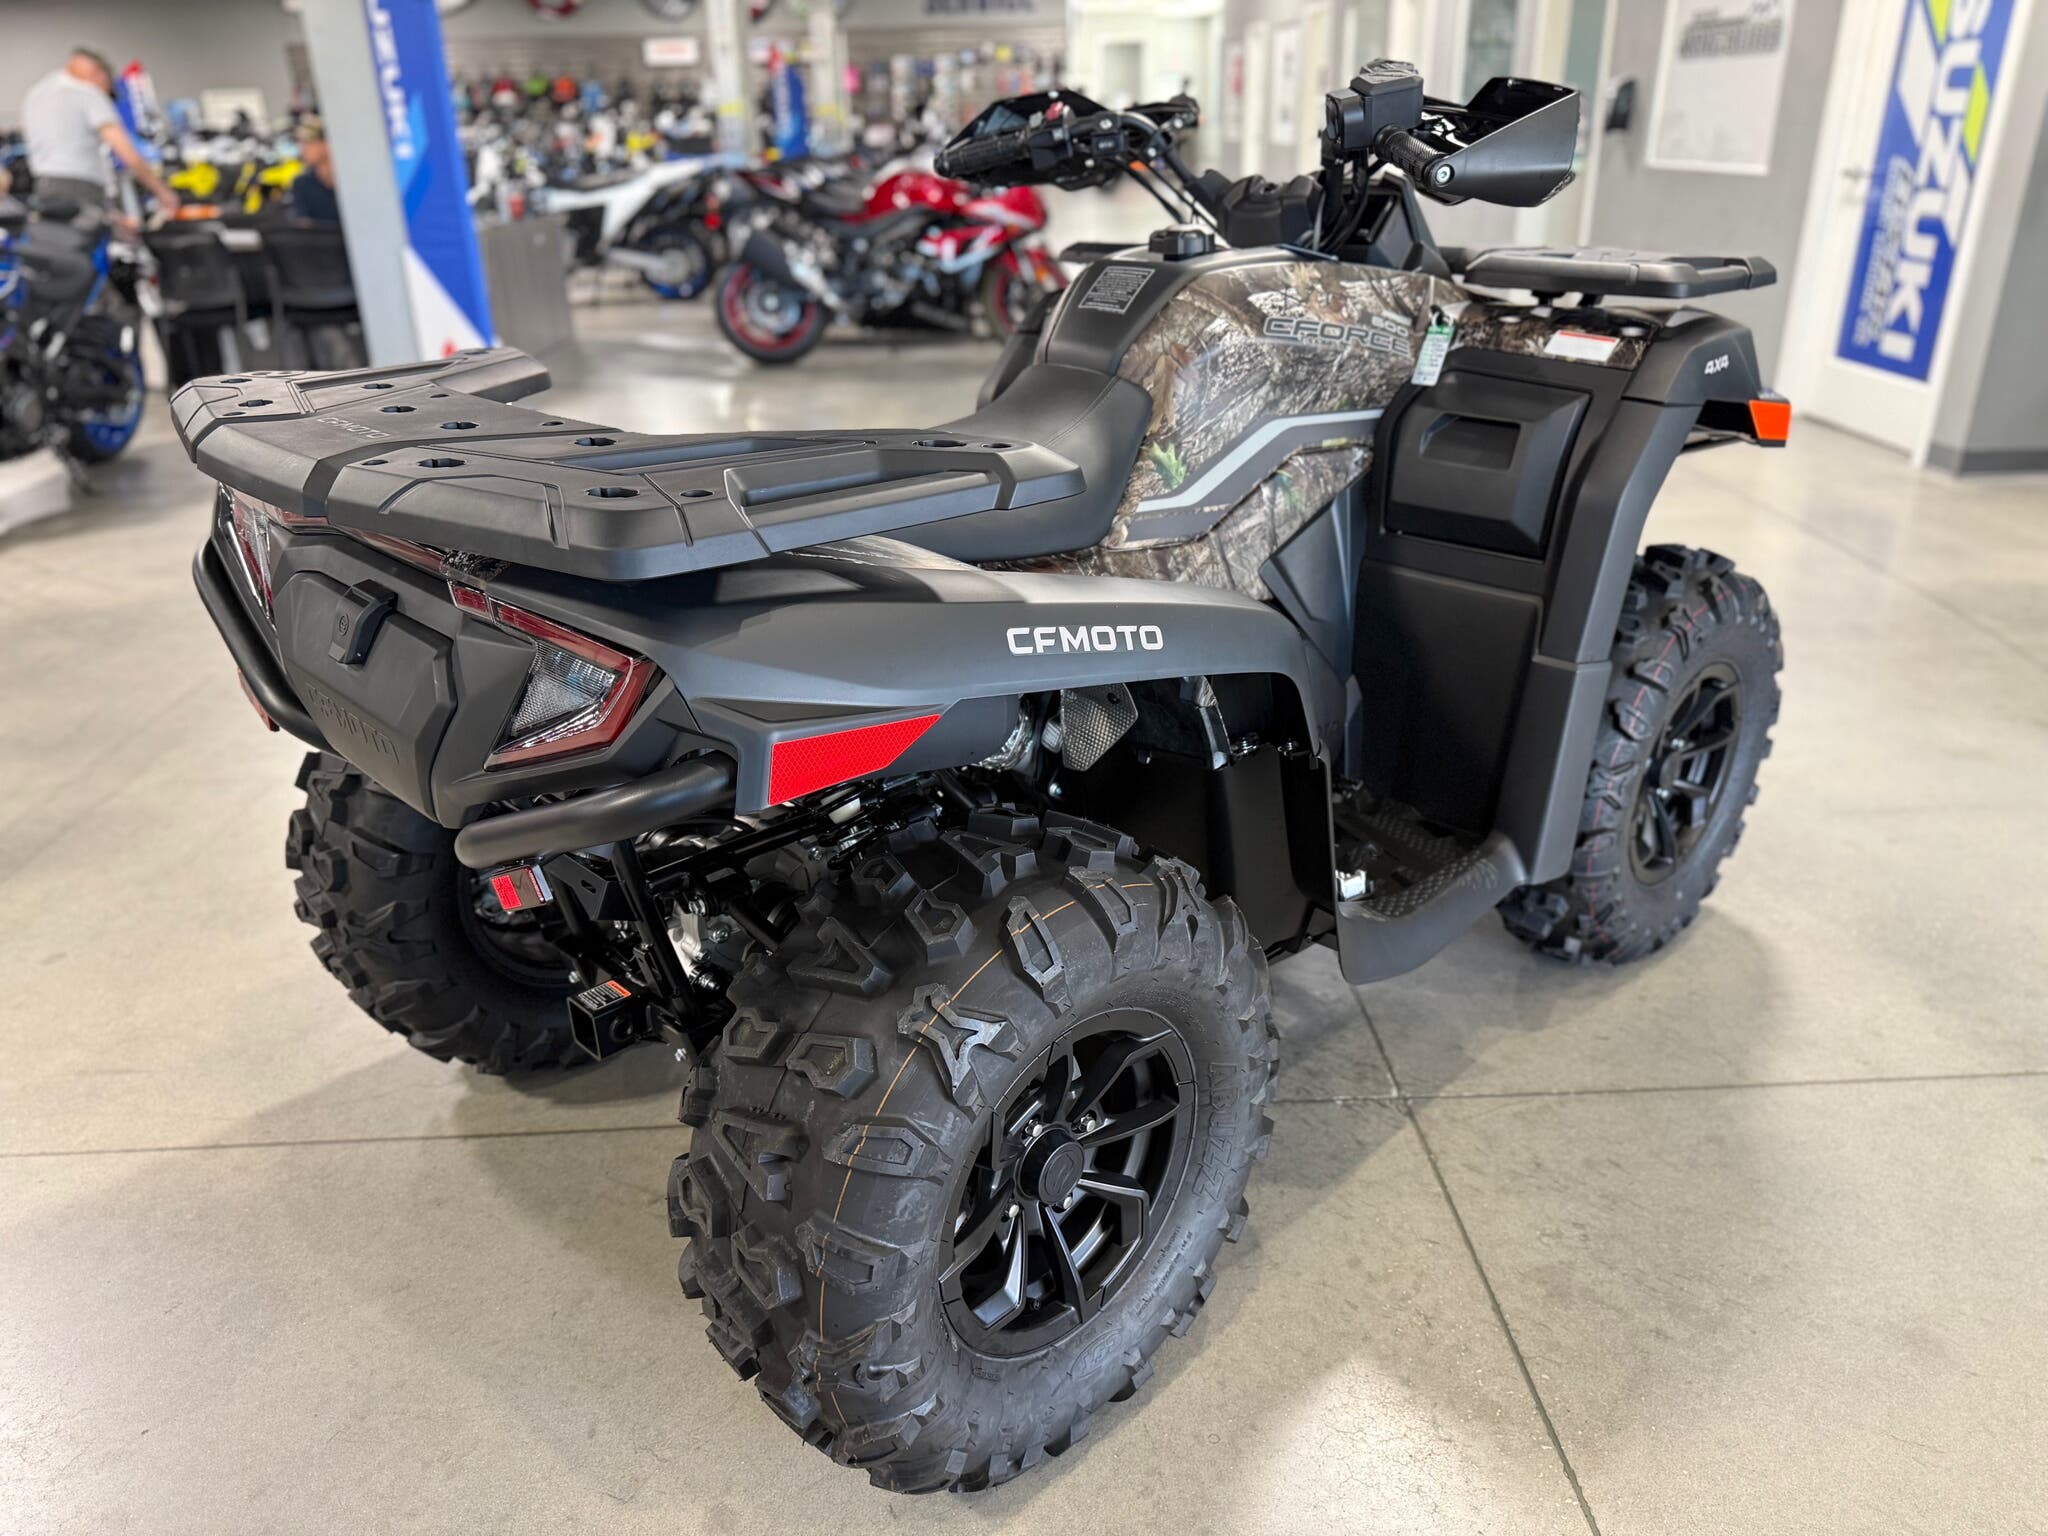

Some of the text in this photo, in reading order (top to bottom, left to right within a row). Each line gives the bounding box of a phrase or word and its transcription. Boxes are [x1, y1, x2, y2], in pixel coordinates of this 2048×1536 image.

[1264, 316, 1411, 358] CFORCE
[317, 417, 390, 438] CFMOTO
[1006, 625, 1164, 655] CFMOTO
[304, 682, 400, 765] CFMOTO
